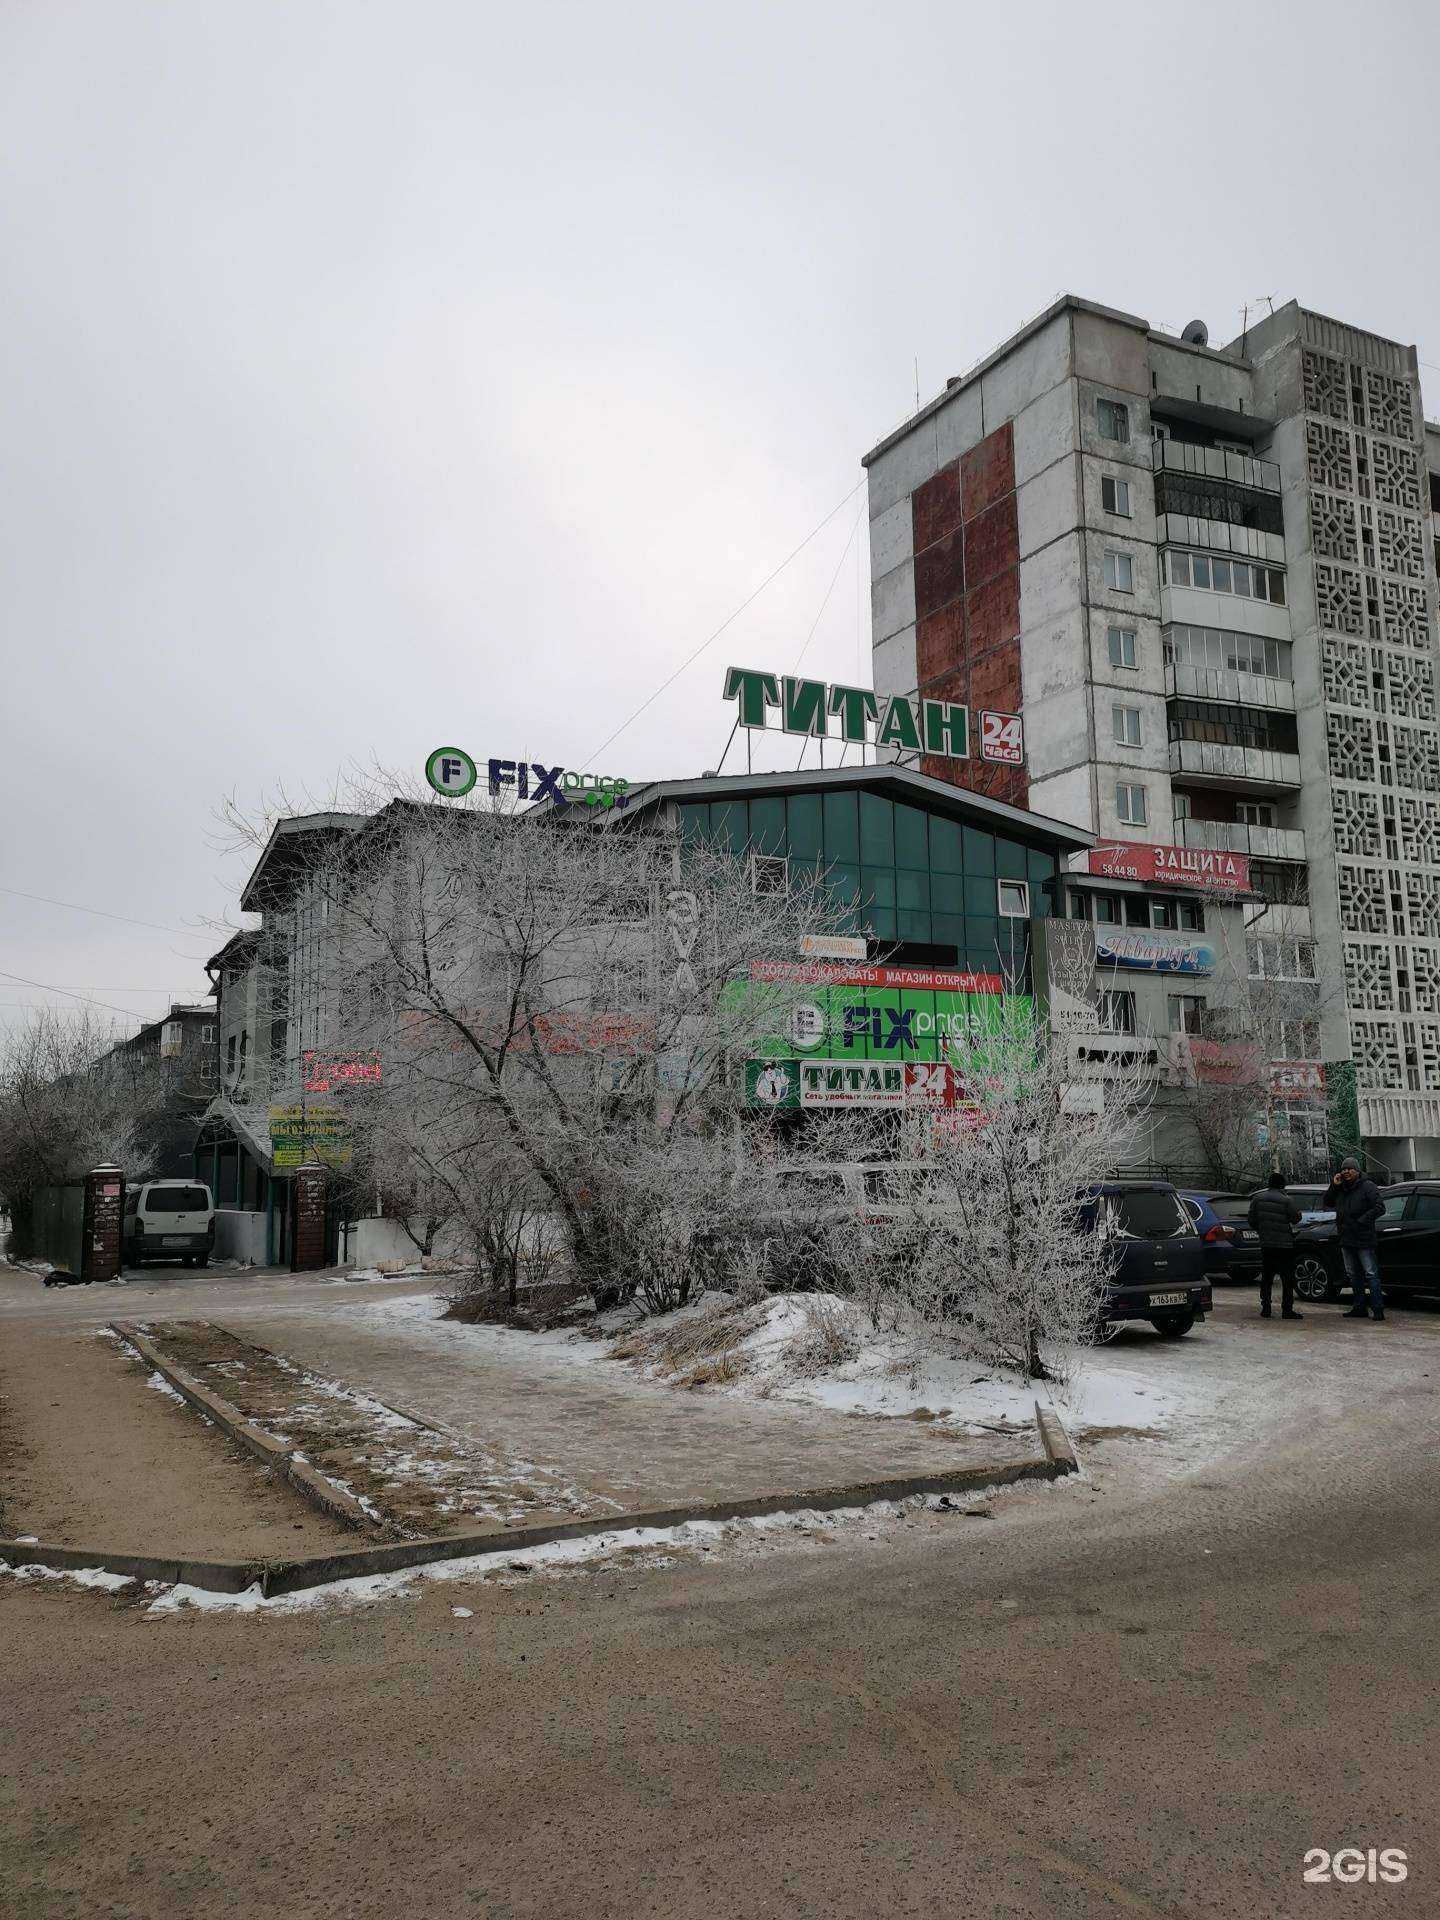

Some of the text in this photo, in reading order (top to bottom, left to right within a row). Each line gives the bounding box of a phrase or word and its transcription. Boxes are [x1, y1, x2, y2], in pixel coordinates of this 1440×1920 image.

[723, 666, 1021, 759] ТИТАН 24
[985, 745, 1019, 759] часа
[489, 758, 569, 807] FIX
[1153, 847, 1237, 876] ЗАЩИТА
[886, 972, 932, 985] МАГАЗИН
[935, 974, 976, 987] ОТКРЫТ
[843, 1006, 920, 1049] FIX
[803, 1065, 947, 1094] ТИТАН 24
